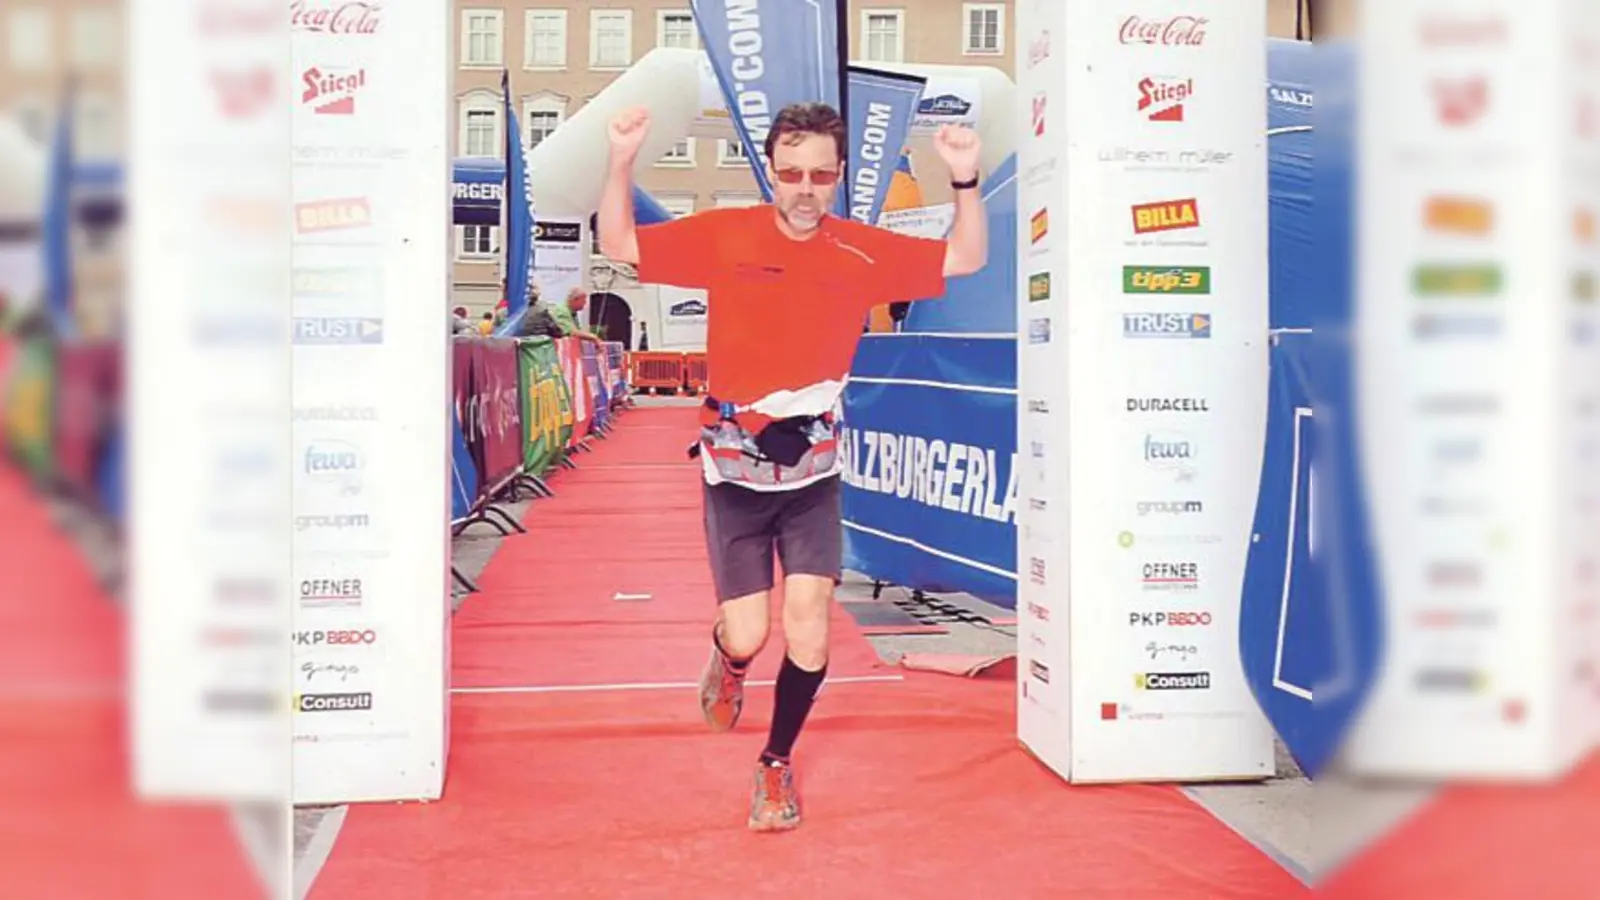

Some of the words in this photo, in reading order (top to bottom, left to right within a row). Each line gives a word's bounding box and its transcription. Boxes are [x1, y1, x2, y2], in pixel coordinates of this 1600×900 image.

[1138, 78, 1193, 110] Stiegl
[1136, 204, 1195, 229] BILLA
[1132, 271, 1202, 291] tipp3
[1123, 314, 1191, 332] TRUST
[1127, 398, 1209, 411] DURACELL
[304, 444, 356, 473] fewa
[1143, 563, 1197, 578] OFFNER
[300, 579, 362, 596] OFFNER
[1147, 674, 1207, 688] Consult
